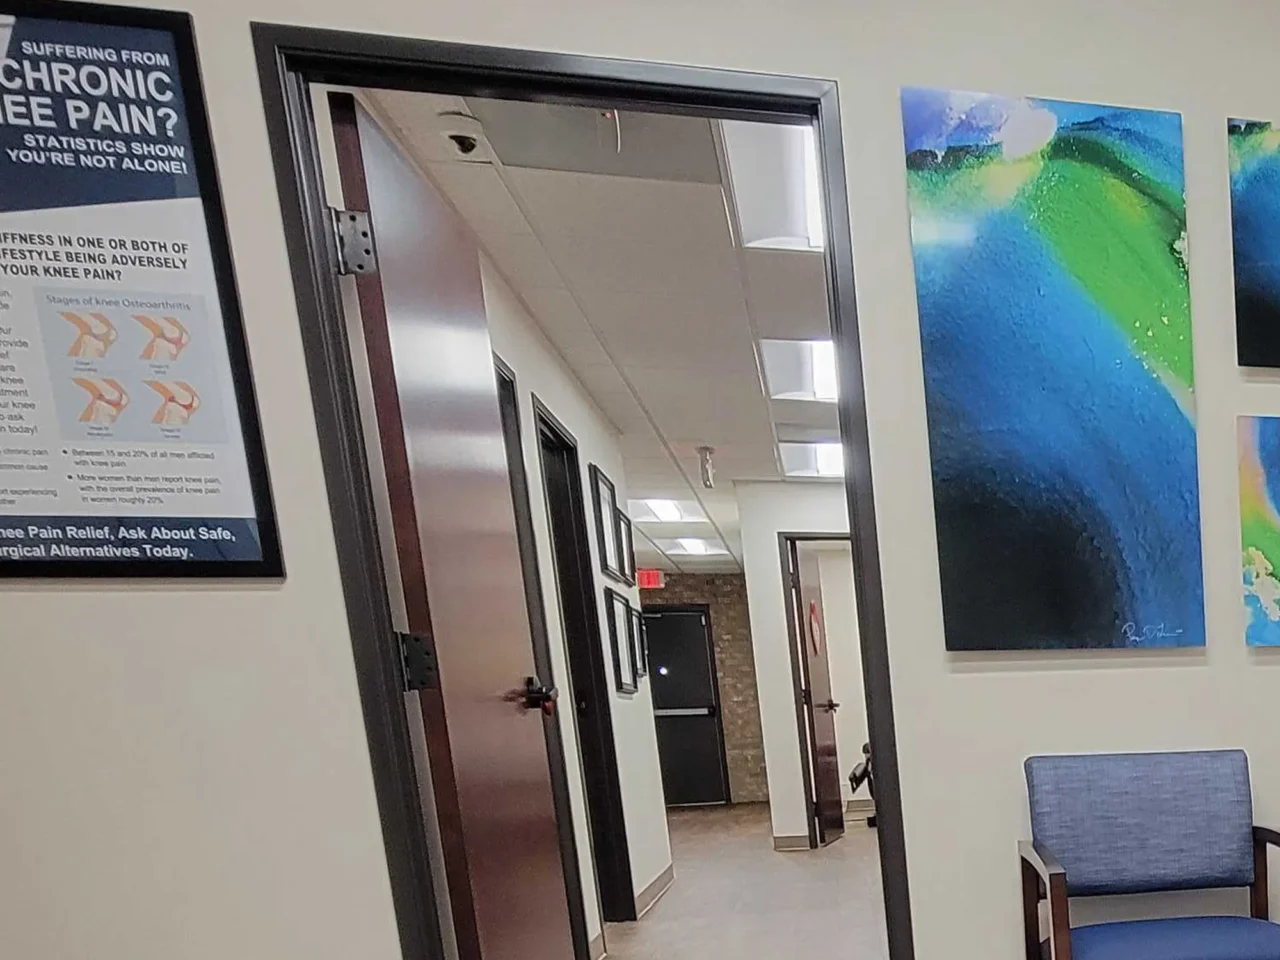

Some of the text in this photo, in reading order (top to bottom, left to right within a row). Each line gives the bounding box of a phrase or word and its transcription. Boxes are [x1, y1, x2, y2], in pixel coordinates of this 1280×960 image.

[21, 41, 170, 67] SUFFERING FROM
[0, 57, 174, 101] CHRONIC
[0, 94, 179, 138] EE PAIN?
[24, 133, 185, 158] STATISTICS SHOW
[7, 149, 189, 175] YOU'RE NOT ALONE!
[58, 235, 73, 247] IN
[77, 236, 105, 249] ONE
[109, 238, 127, 251] OR
[131, 240, 168, 253] BOTH
[172, 242, 189, 254] OF
[0, 248, 188, 270] FESTYLE BEING ADVERSELY
[0, 263, 122, 281] YOUR KNEE PAIN?
[28, 525, 60, 539] Pain
[66, 526, 115, 541] Relief,
[118, 526, 147, 540] Ask
[150, 527, 196, 540] About
[198, 526, 236, 542] Safe,
[50, 544, 140, 558] Alternatives
[142, 544, 194, 560] Today.
